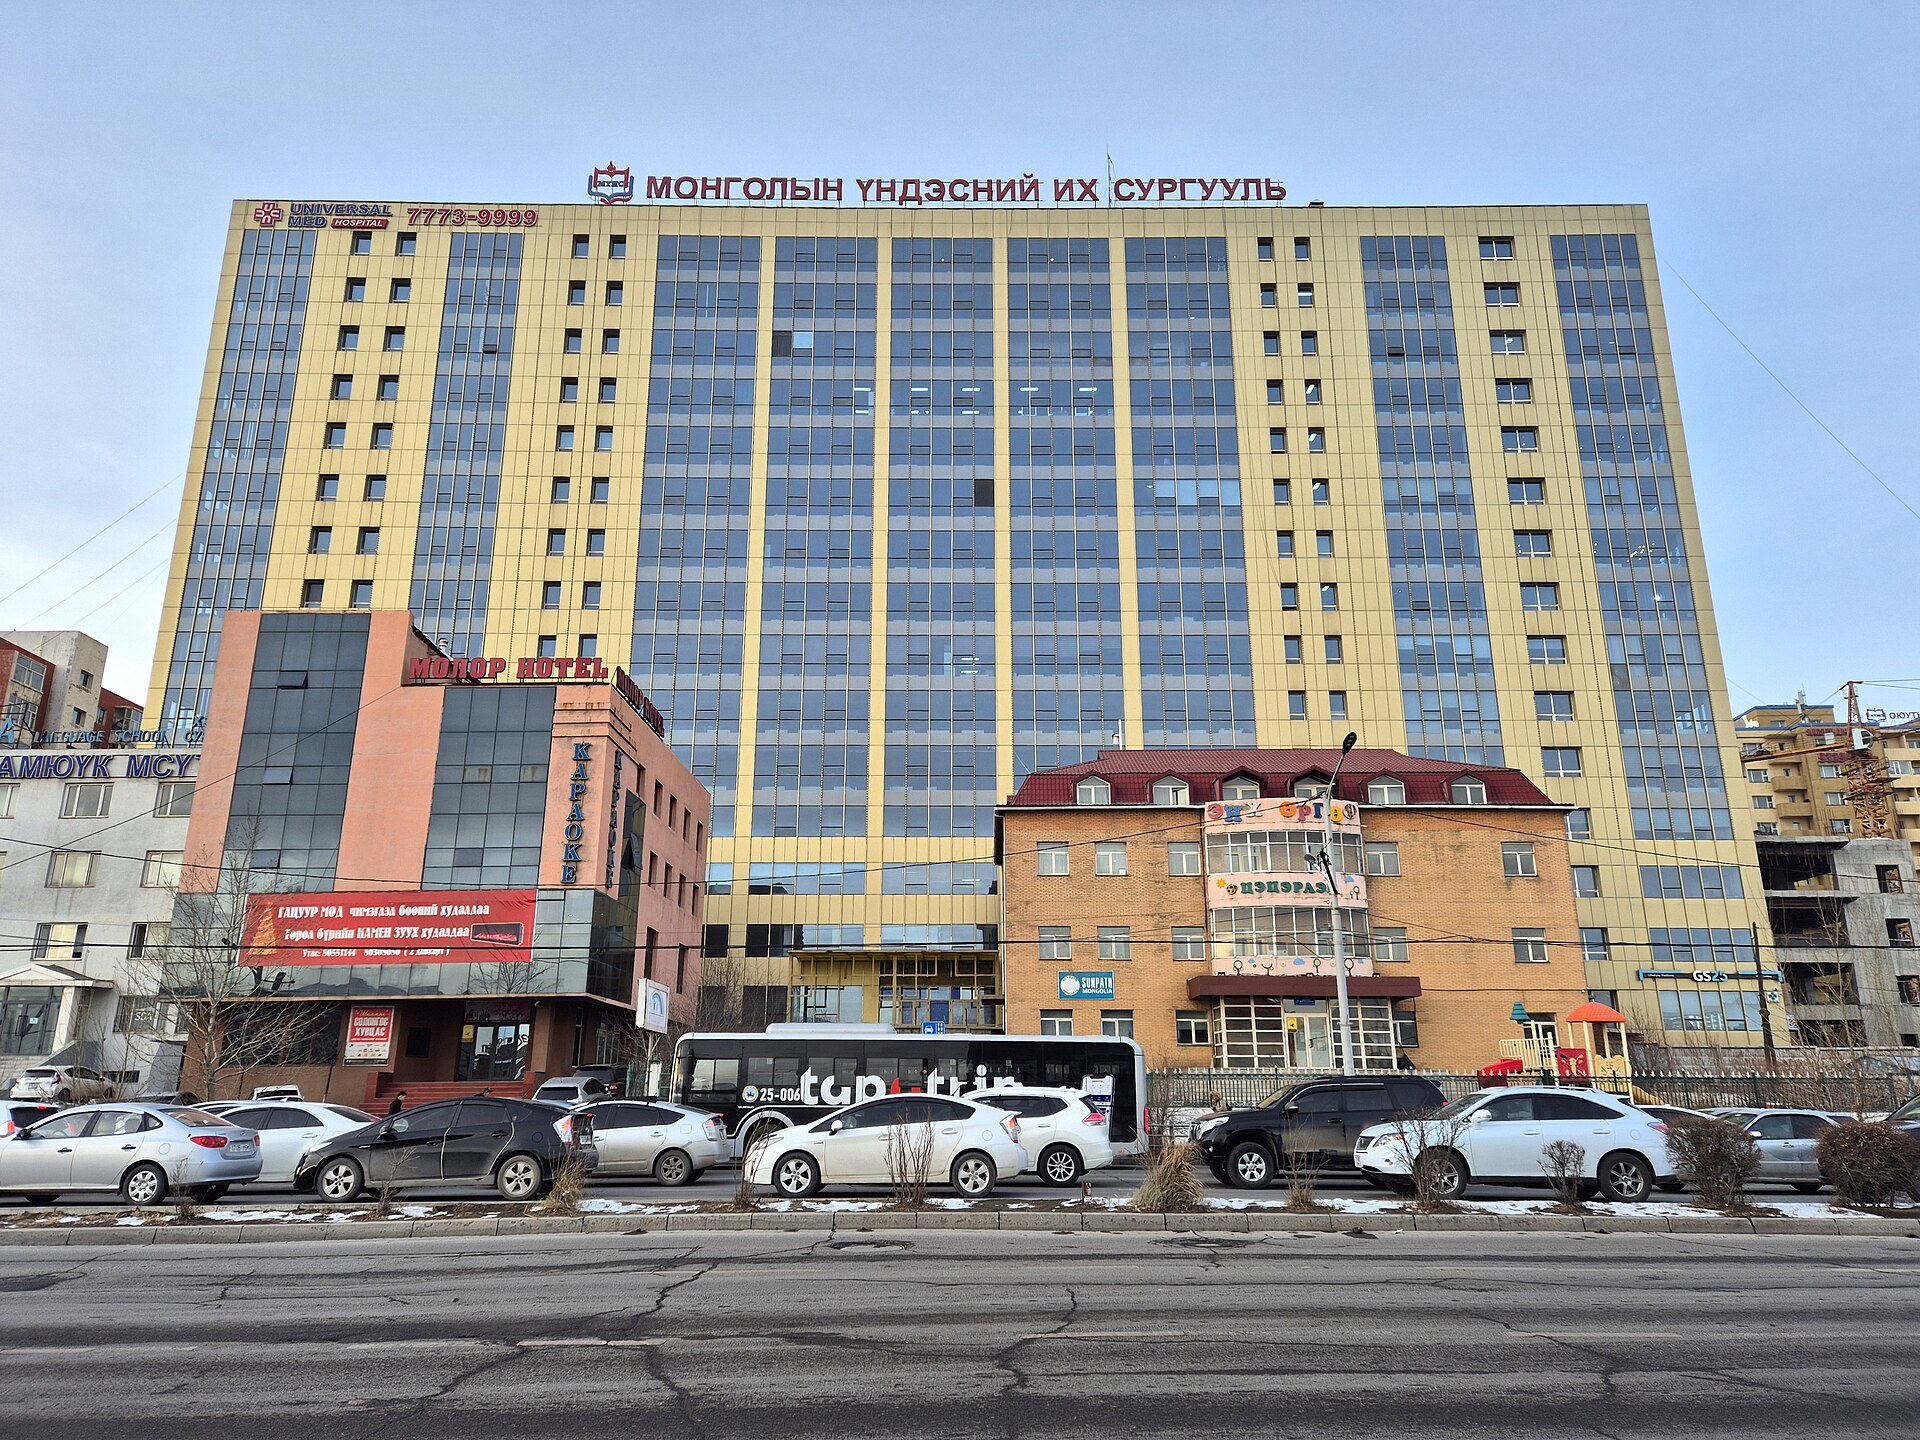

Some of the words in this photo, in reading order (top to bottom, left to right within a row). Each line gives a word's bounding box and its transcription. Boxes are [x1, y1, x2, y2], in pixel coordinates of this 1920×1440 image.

[647, 175, 843, 201] МОНГОЛЫН
[856, 173, 1040, 206] ҮНДЭСНИЙ
[1053, 178, 1099, 201] ИХ
[1113, 178, 1287, 201] СУРГУУЛЬ
[290, 203, 393, 216] UNIVERSAL
[288, 216, 327, 228] MED
[334, 218, 384, 227] HOSPITAL
[406, 207, 538, 227] 7773-9999
[408, 657, 507, 680] МОЛОР
[516, 657, 608, 679] HOTEL
[560, 742, 592, 884] КАРАОКЕ
[1240, 881, 1330, 894] ЦЭЦЭРЛЭ
[320, 905, 343, 918] МОД
[440, 905, 490, 917] худалдаа
[357, 927, 391, 938] КАМЕН
[393, 927, 419, 938] ЗУУХ
[421, 927, 469, 939] худалдаа
[1692, 970, 1728, 982] GS25
[1081, 977, 1112, 989] SUNPATH
